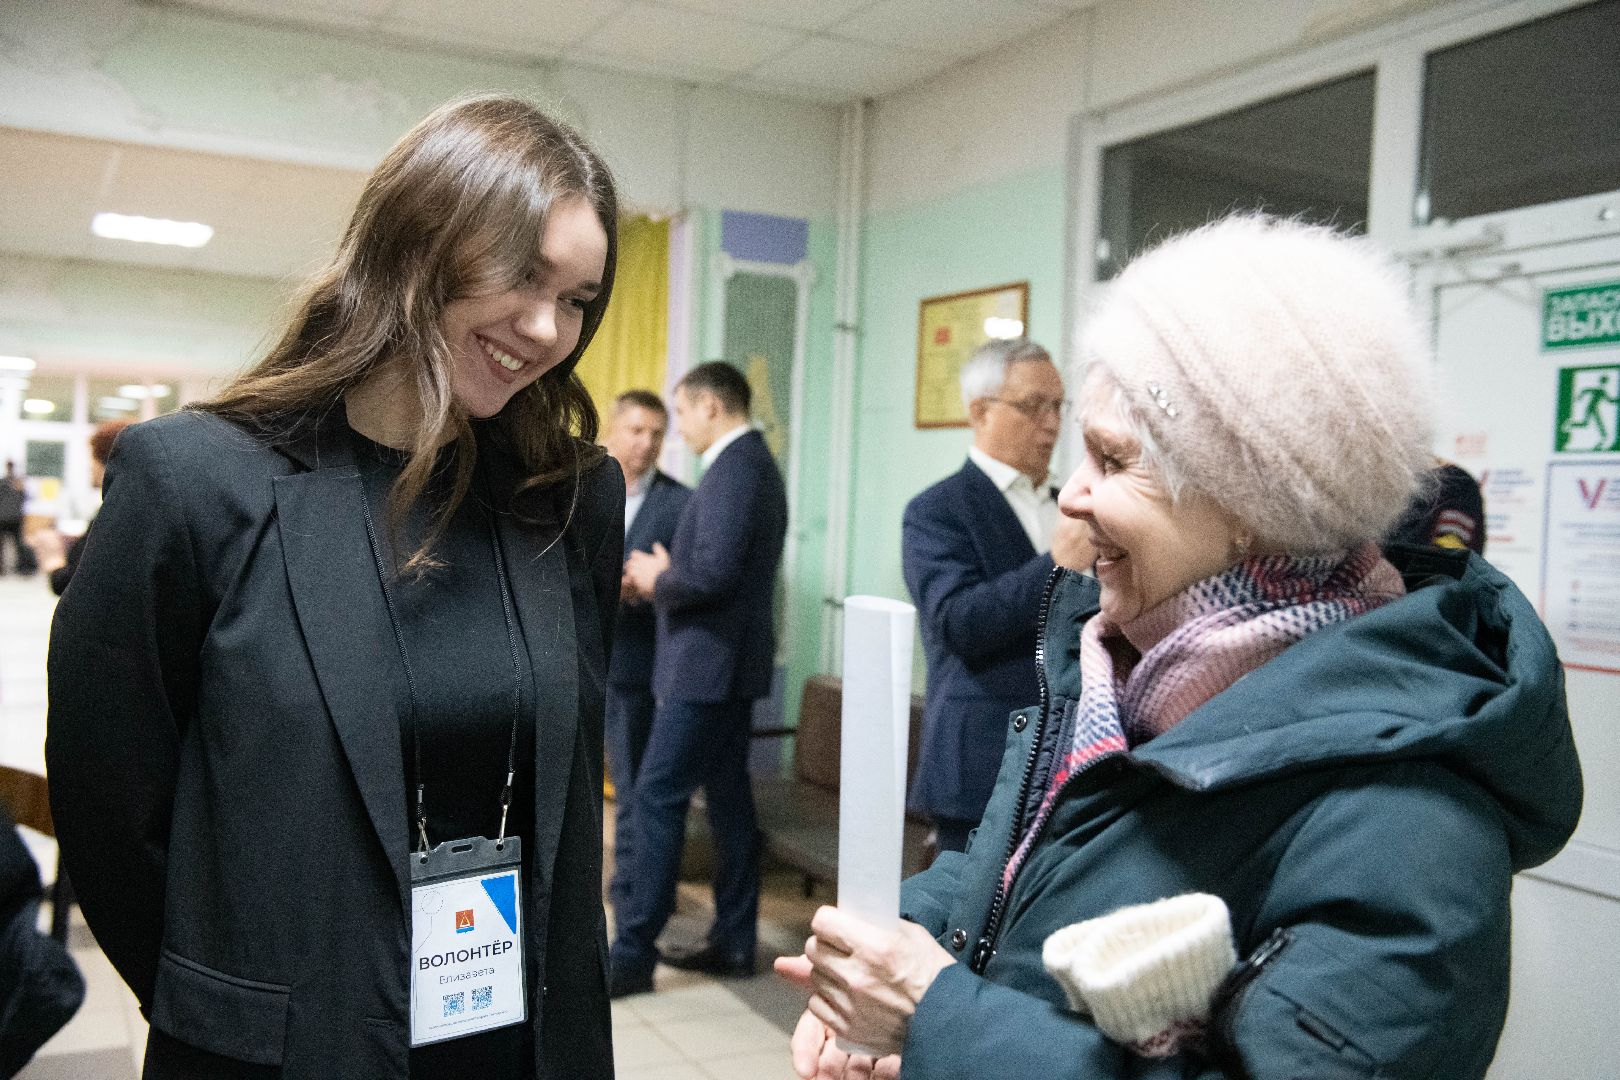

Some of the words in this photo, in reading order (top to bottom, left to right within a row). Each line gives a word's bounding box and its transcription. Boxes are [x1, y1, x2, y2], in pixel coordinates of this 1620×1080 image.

[1547, 309, 1620, 341] ВЫХ
[419, 939, 513, 971] ВОЛОНТЁР
[439, 967, 495, 985] Елизавета
